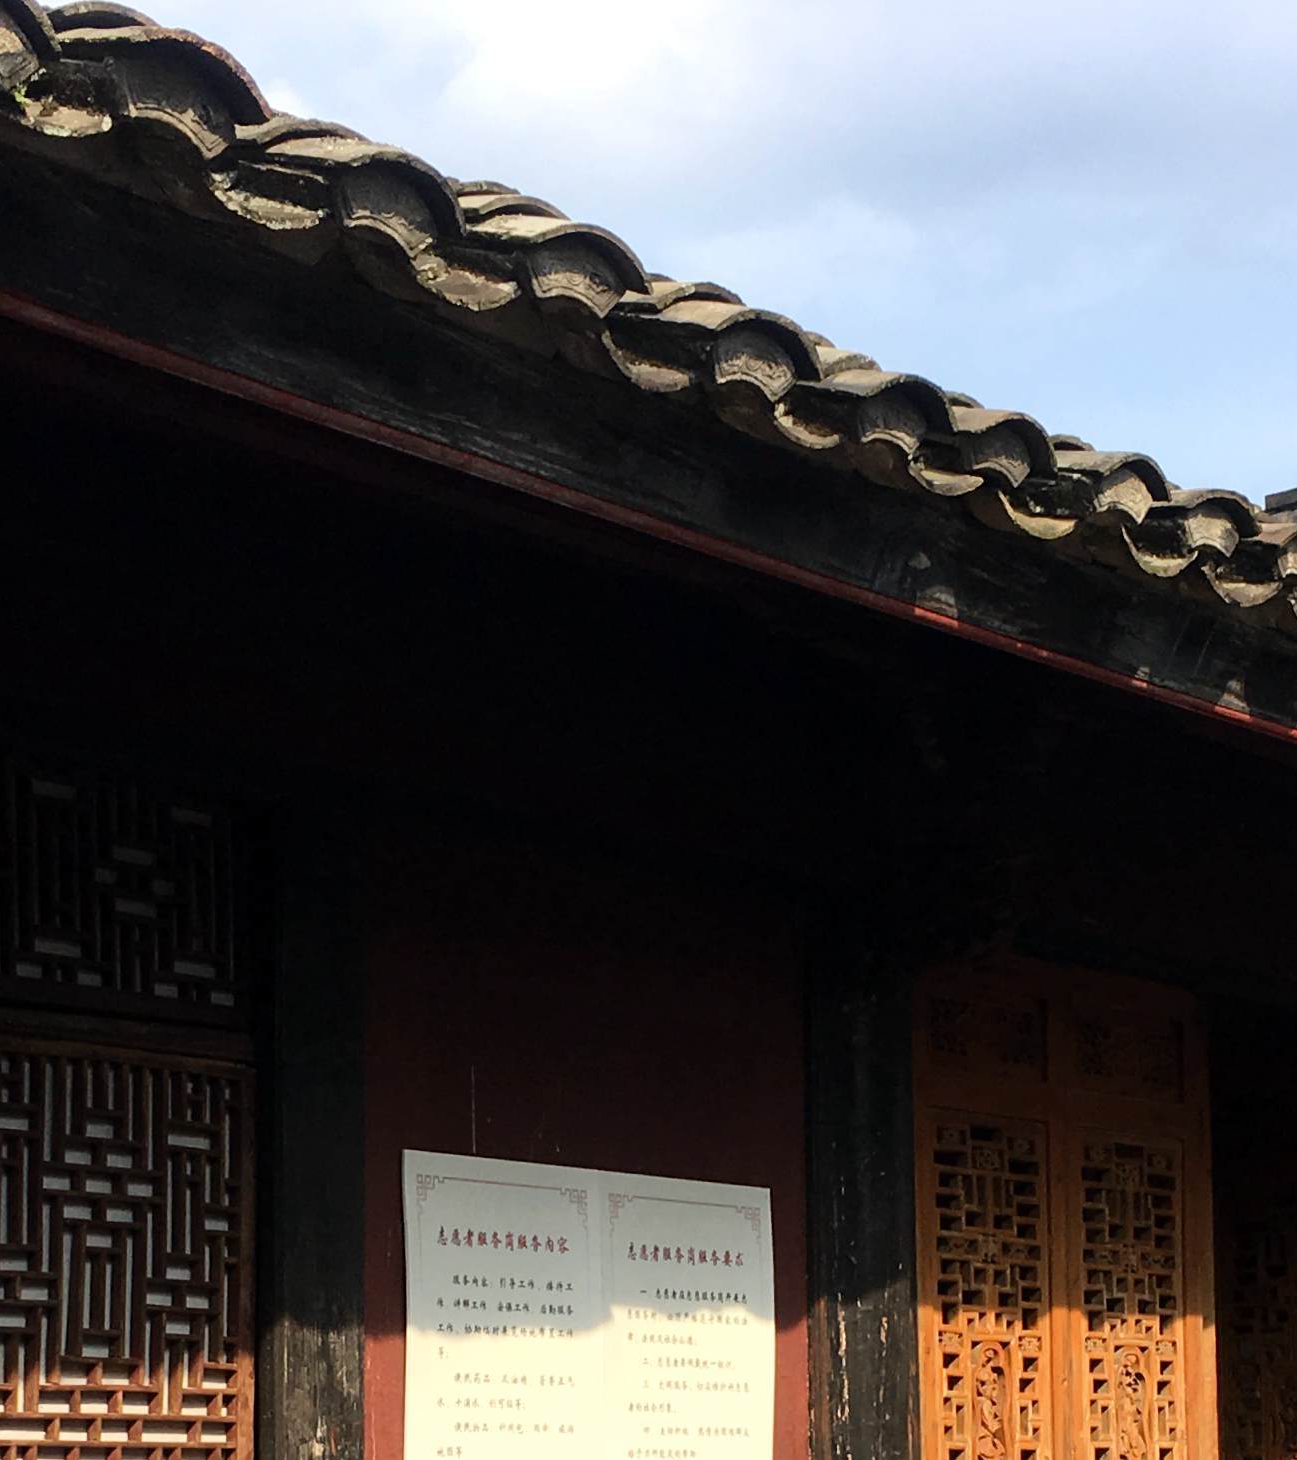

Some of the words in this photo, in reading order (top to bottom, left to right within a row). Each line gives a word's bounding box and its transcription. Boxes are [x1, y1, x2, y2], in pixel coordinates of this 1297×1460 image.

[437, 1225, 569, 1254] 志愿者服务岗服务内容
[627, 1241, 744, 1267] 志愿者服务岗服务要求
